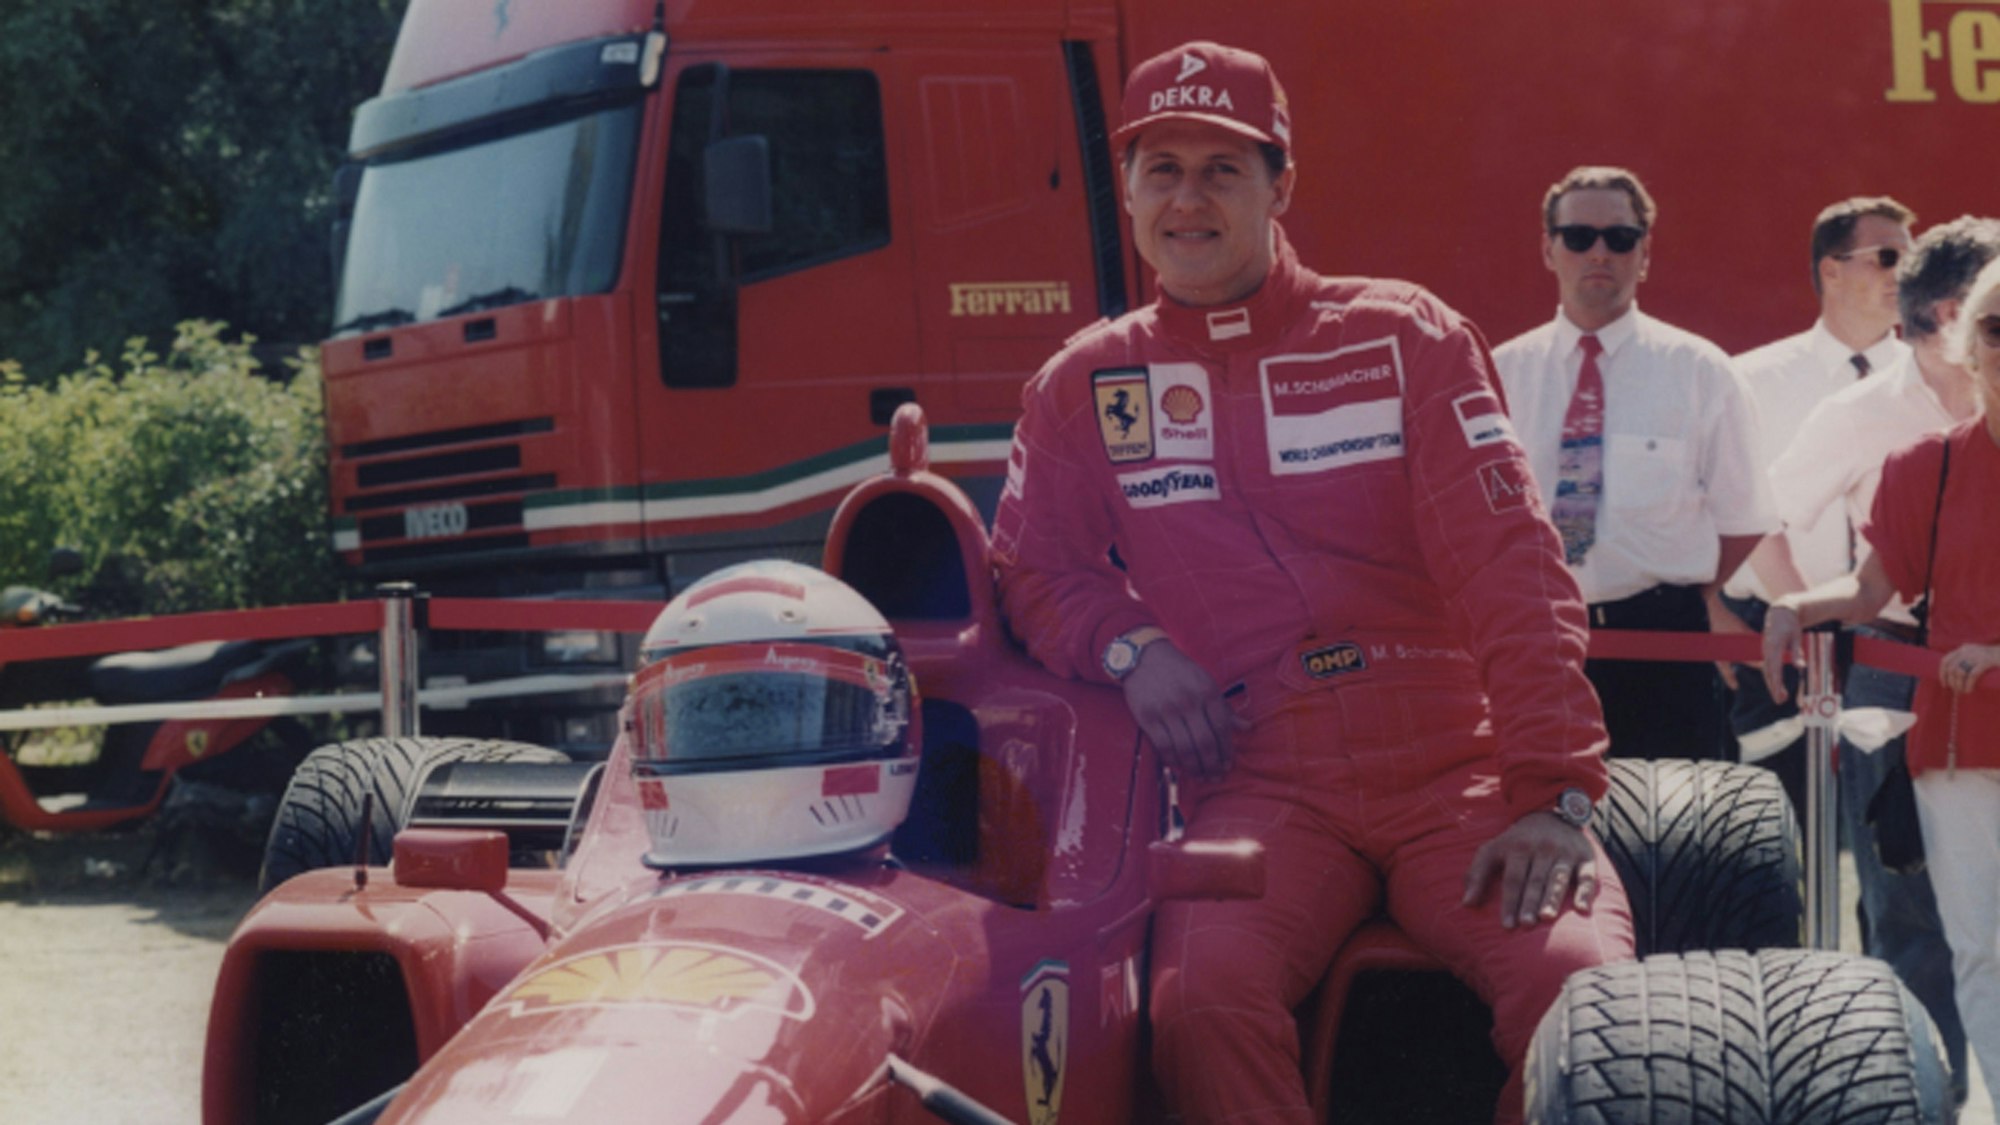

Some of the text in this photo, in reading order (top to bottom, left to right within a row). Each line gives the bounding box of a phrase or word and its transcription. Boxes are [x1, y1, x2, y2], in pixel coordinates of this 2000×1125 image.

[1150, 86, 1234, 112] DEKRA
[949, 281, 1071, 316] Ferrari
[1161, 427, 1208, 440] Shell
[404, 503, 468, 538] IVECO
[1308, 649, 1358, 673] OMP
